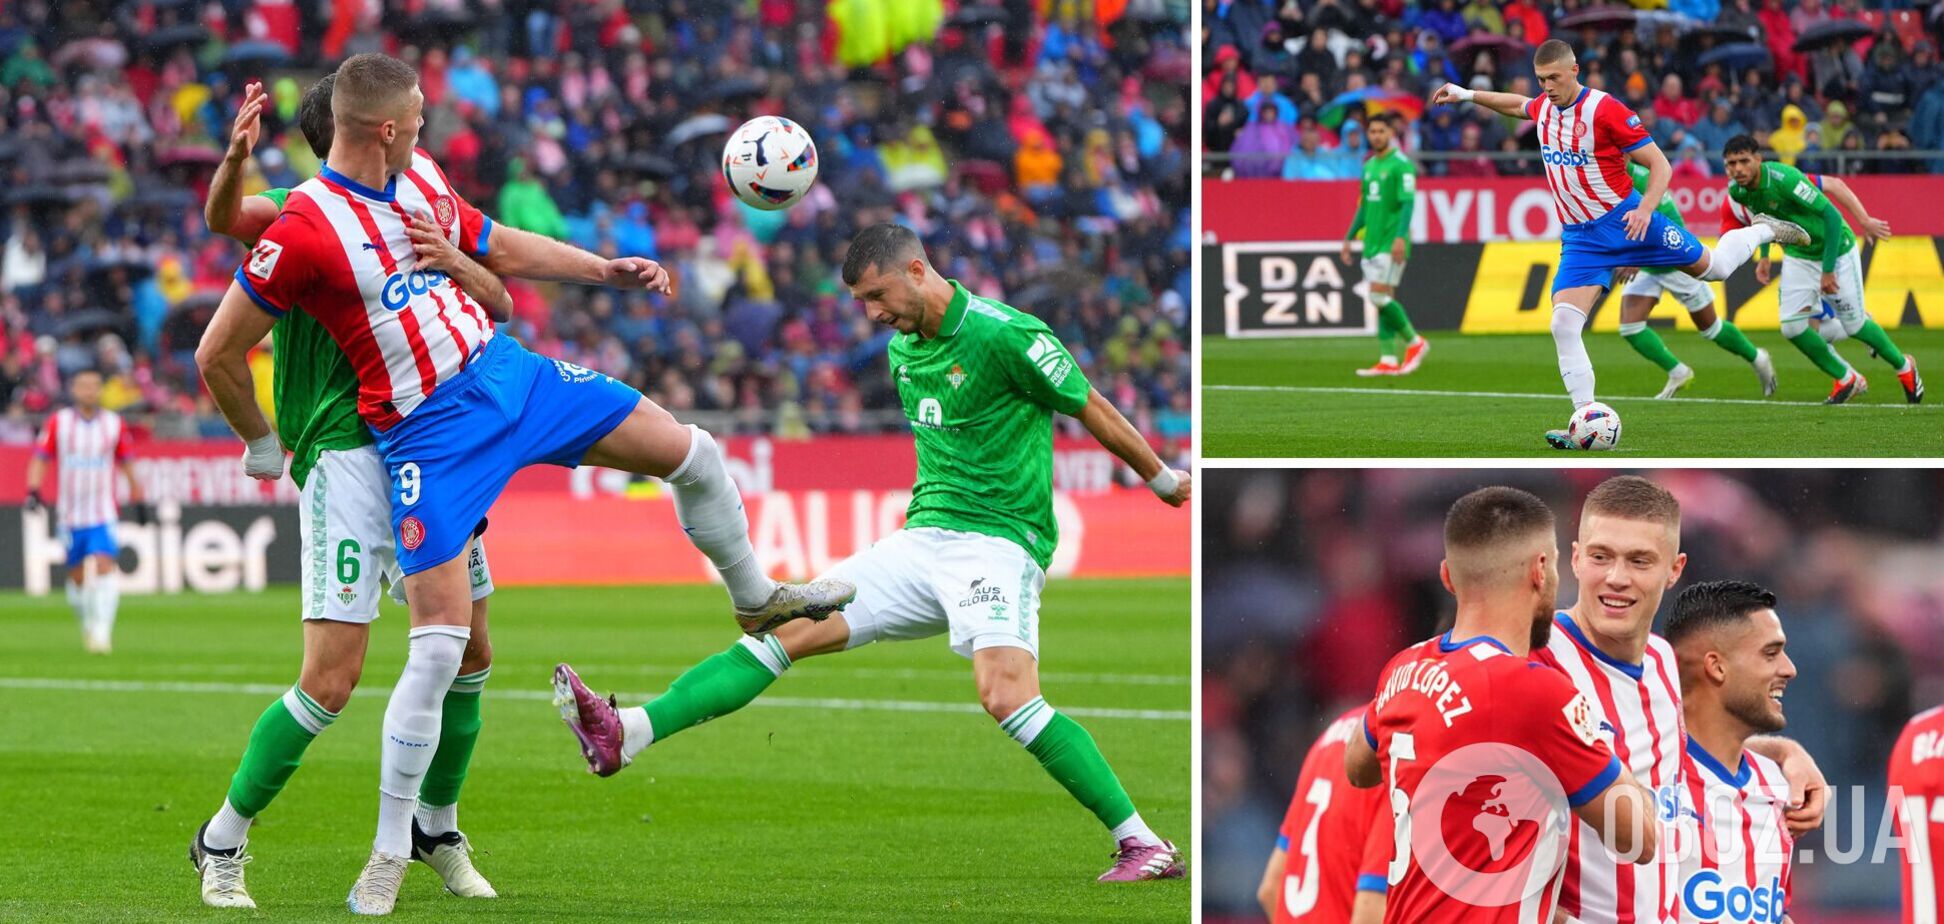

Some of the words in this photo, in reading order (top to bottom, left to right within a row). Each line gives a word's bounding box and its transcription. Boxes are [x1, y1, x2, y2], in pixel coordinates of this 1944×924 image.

[1541, 145, 1589, 166] Gosbi
[381, 270, 447, 311] Gos
[1260, 256, 1345, 290] DA
[1261, 291, 1343, 324] ZN
[399, 462, 421, 506] 9
[336, 538, 361, 585] 6
[958, 594, 1010, 608] GLOBAL
[974, 586, 1001, 596] AUS
[1411, 660, 1473, 728] LÓPEZ
[1284, 776, 1332, 909] 3
[1684, 870, 1785, 924] Gosb
